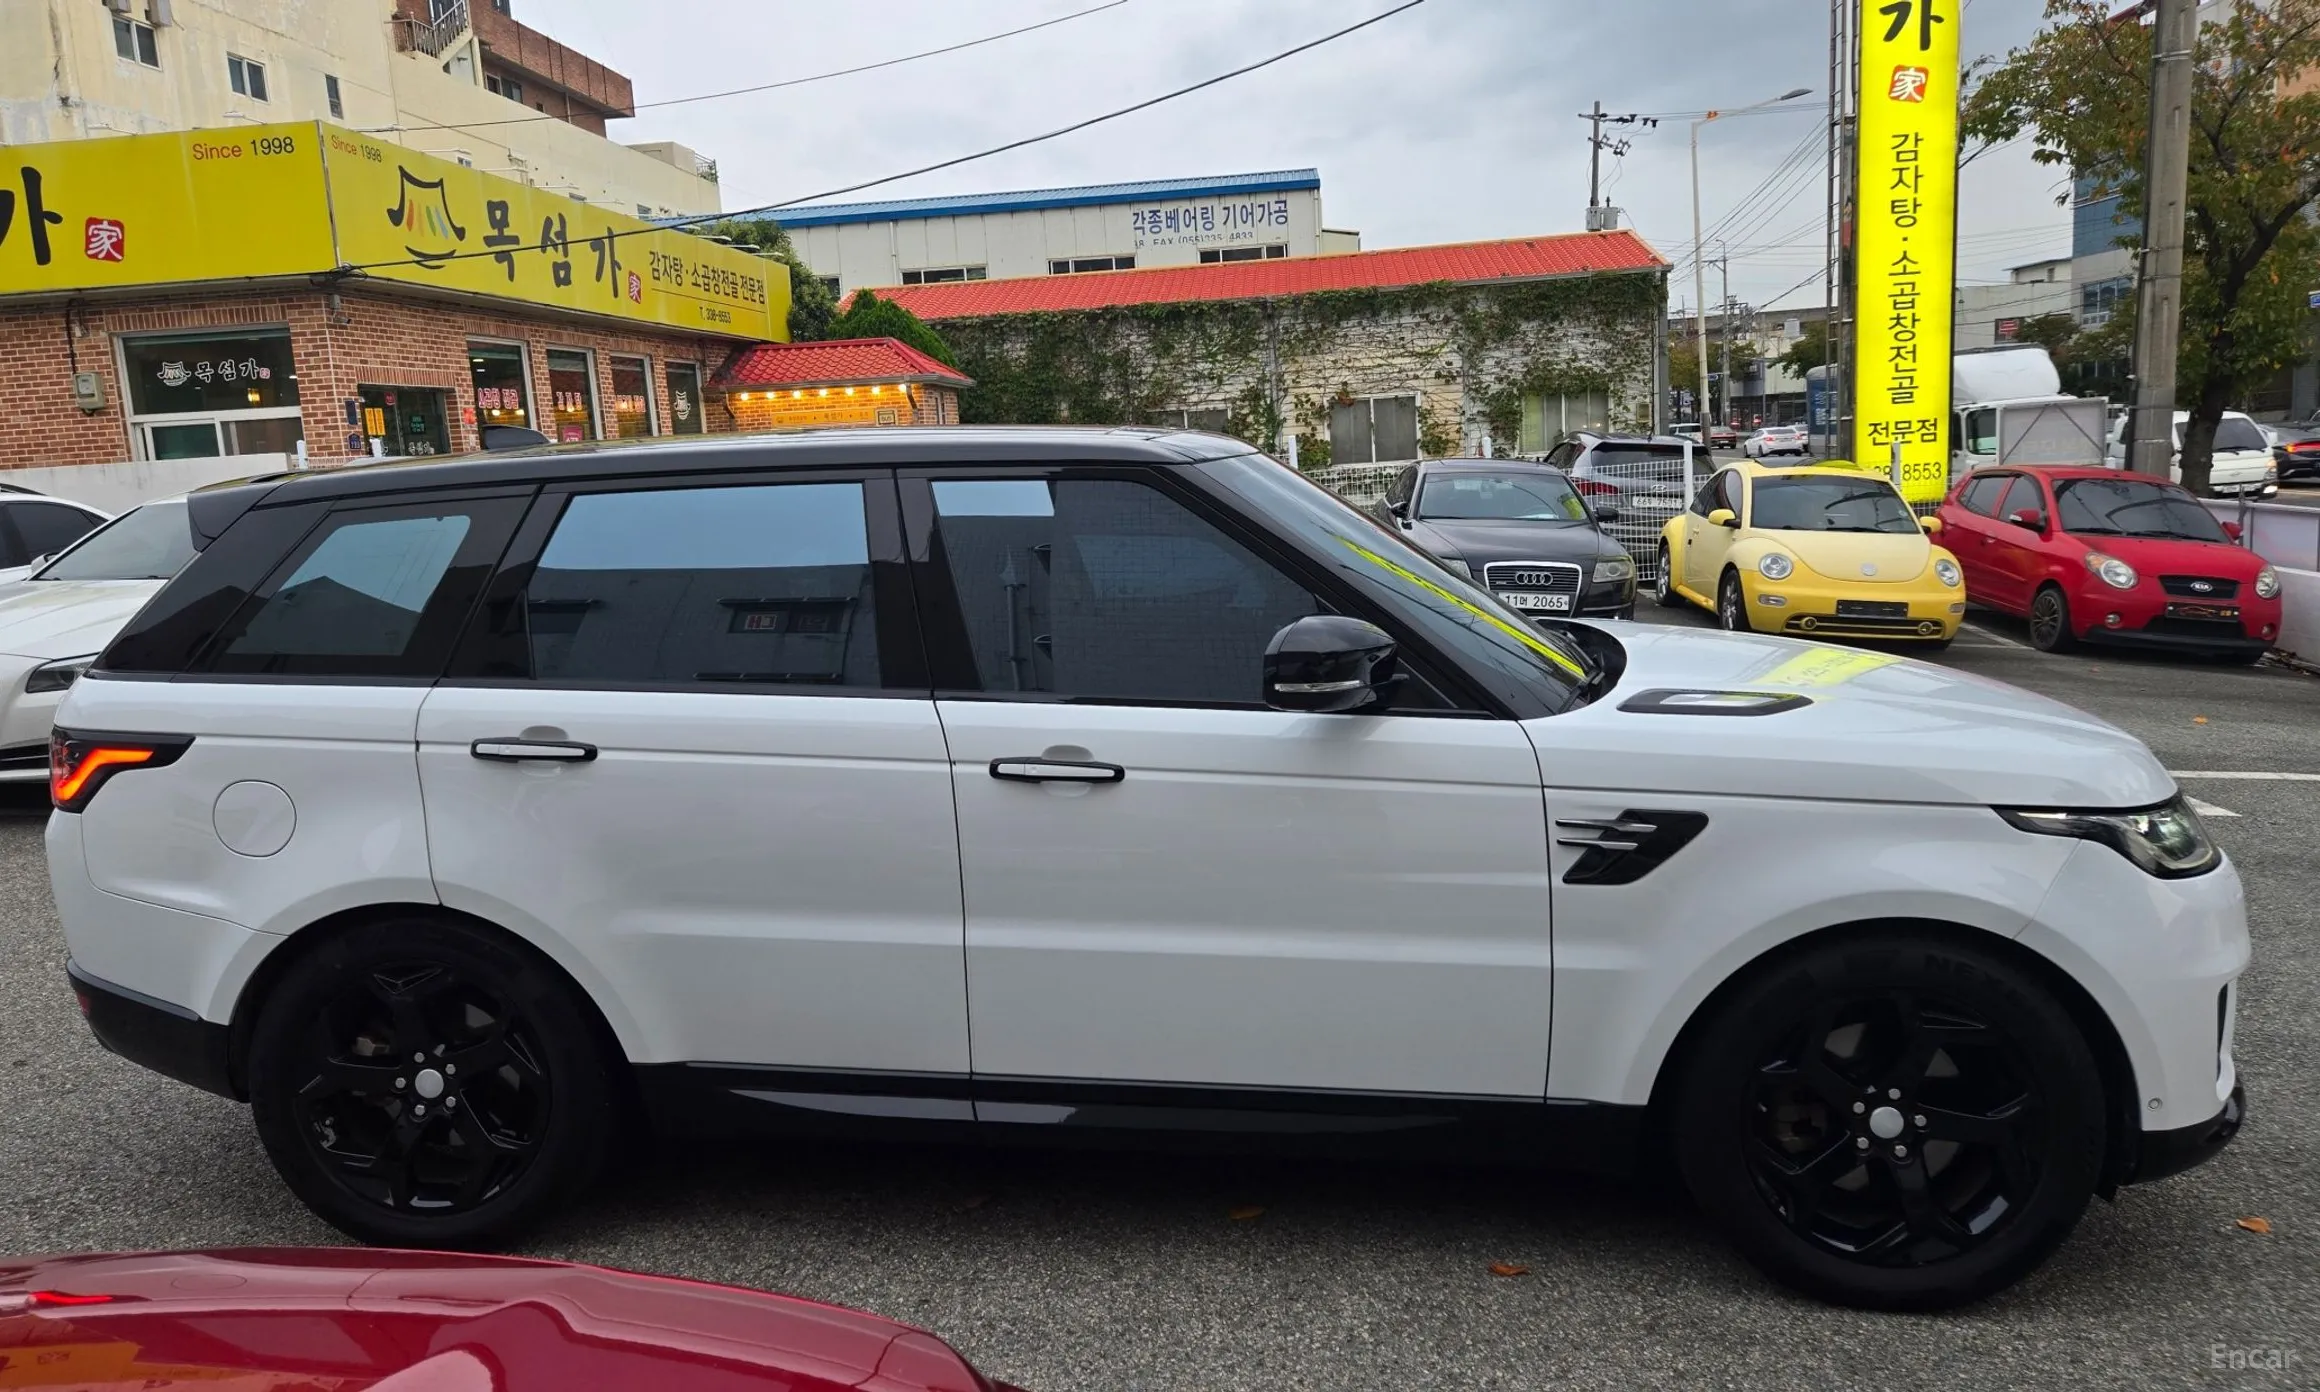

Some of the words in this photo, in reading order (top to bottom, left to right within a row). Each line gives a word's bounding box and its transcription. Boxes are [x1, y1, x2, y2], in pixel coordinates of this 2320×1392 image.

[192, 143, 243, 160] Since
[250, 136, 295, 156] 1998
[331, 134, 357, 156] Since
[360, 143, 382, 163] 1998
[1132, 204, 1215, 235] 각종베어링
[1222, 200, 1288, 229] 기어가공
[86, 219, 123, 261] 家
[483, 199, 622, 298] 목섬가
[740, 275, 765, 304] 전문점
[195, 358, 260, 383] 목섬가
[1868, 418, 1938, 446] 전문점
[1533, 595, 1563, 608] 2065
